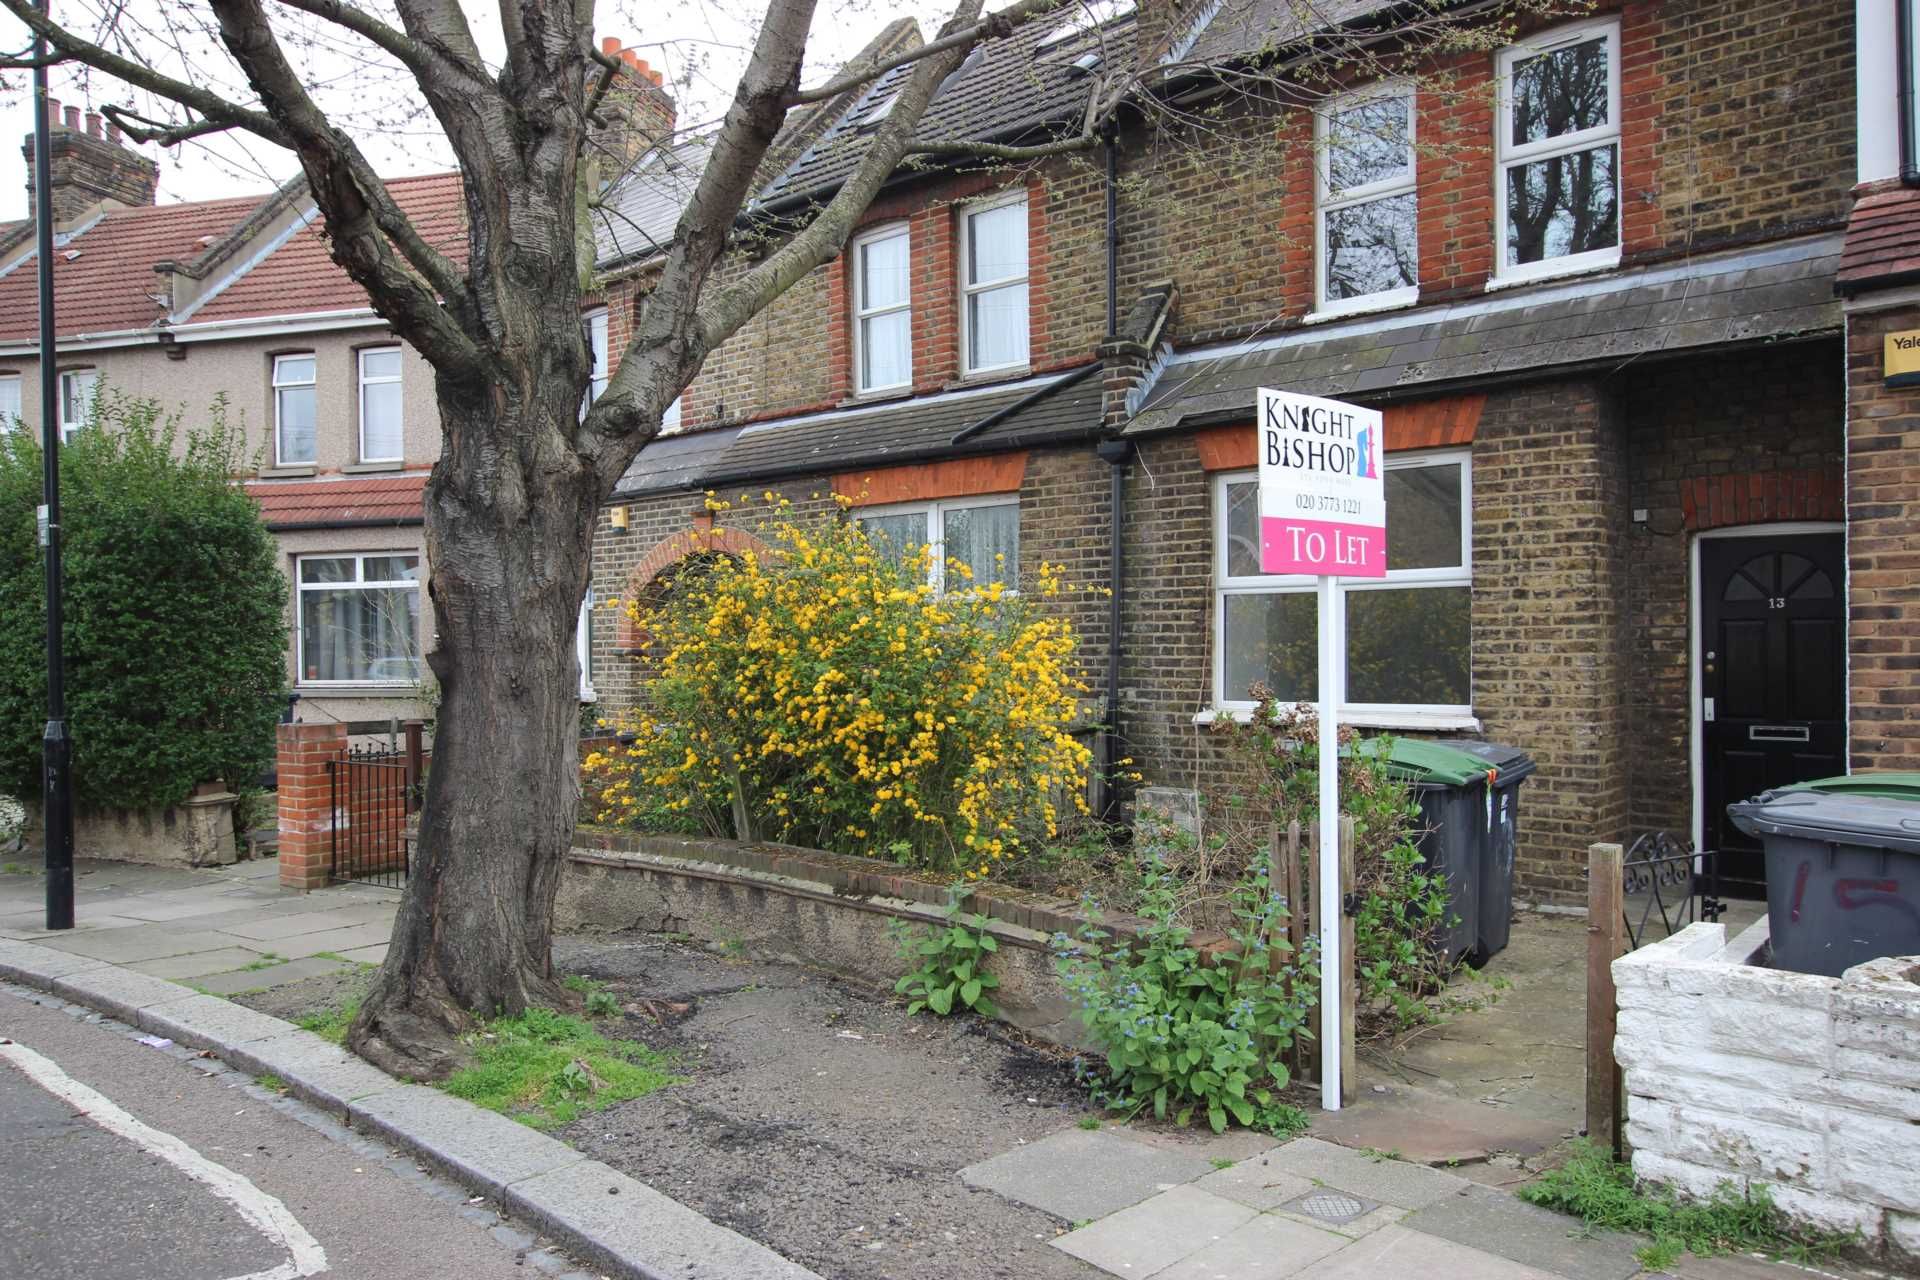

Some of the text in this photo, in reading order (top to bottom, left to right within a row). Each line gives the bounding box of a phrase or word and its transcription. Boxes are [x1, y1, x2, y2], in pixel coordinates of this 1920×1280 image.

[1295, 493, 1315, 510] 020
[1317, 495, 1341, 513] 3773
[1286, 526, 1369, 565] TO LET
[1768, 597, 1785, 609] 13
